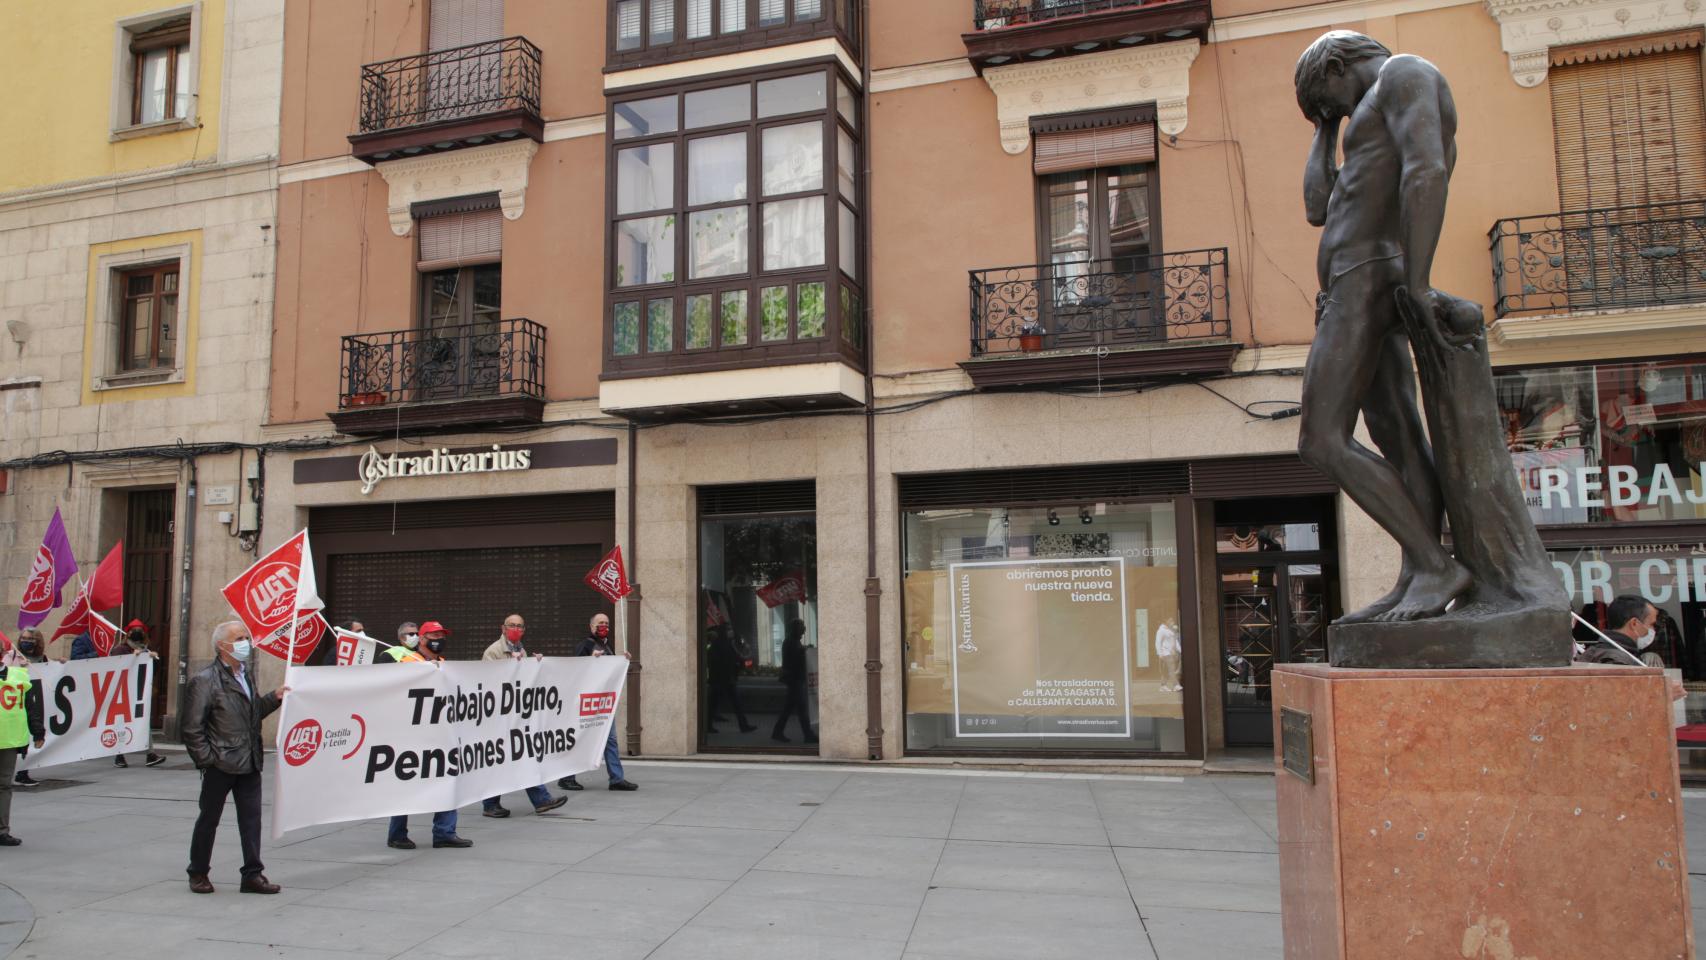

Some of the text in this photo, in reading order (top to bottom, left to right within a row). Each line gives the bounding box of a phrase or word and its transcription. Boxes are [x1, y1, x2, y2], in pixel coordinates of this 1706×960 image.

[376, 443, 531, 478] stradivarius
[1007, 567, 1112, 581] abriremos pronto
[250, 566, 300, 611] UGT
[1024, 580, 1113, 591] nuestra nueva
[1071, 591, 1114, 602] tienda.
[959, 574, 972, 645] stradivarius
[1036, 679, 1114, 687] Nos trasladamos
[89, 664, 147, 728] YA!
[1022, 689, 1034, 697] de
[1036, 688, 1062, 696] PLAZA
[1064, 688, 1107, 696] SAGASTA
[408, 680, 562, 726] Trabajo Digno,
[1074, 698, 1104, 706] CLARA
[288, 725, 319, 746] UGT
[324, 728, 351, 739] Castilla
[322, 737, 347, 749] y León
[364, 725, 575, 784] Pensiones Dignas
